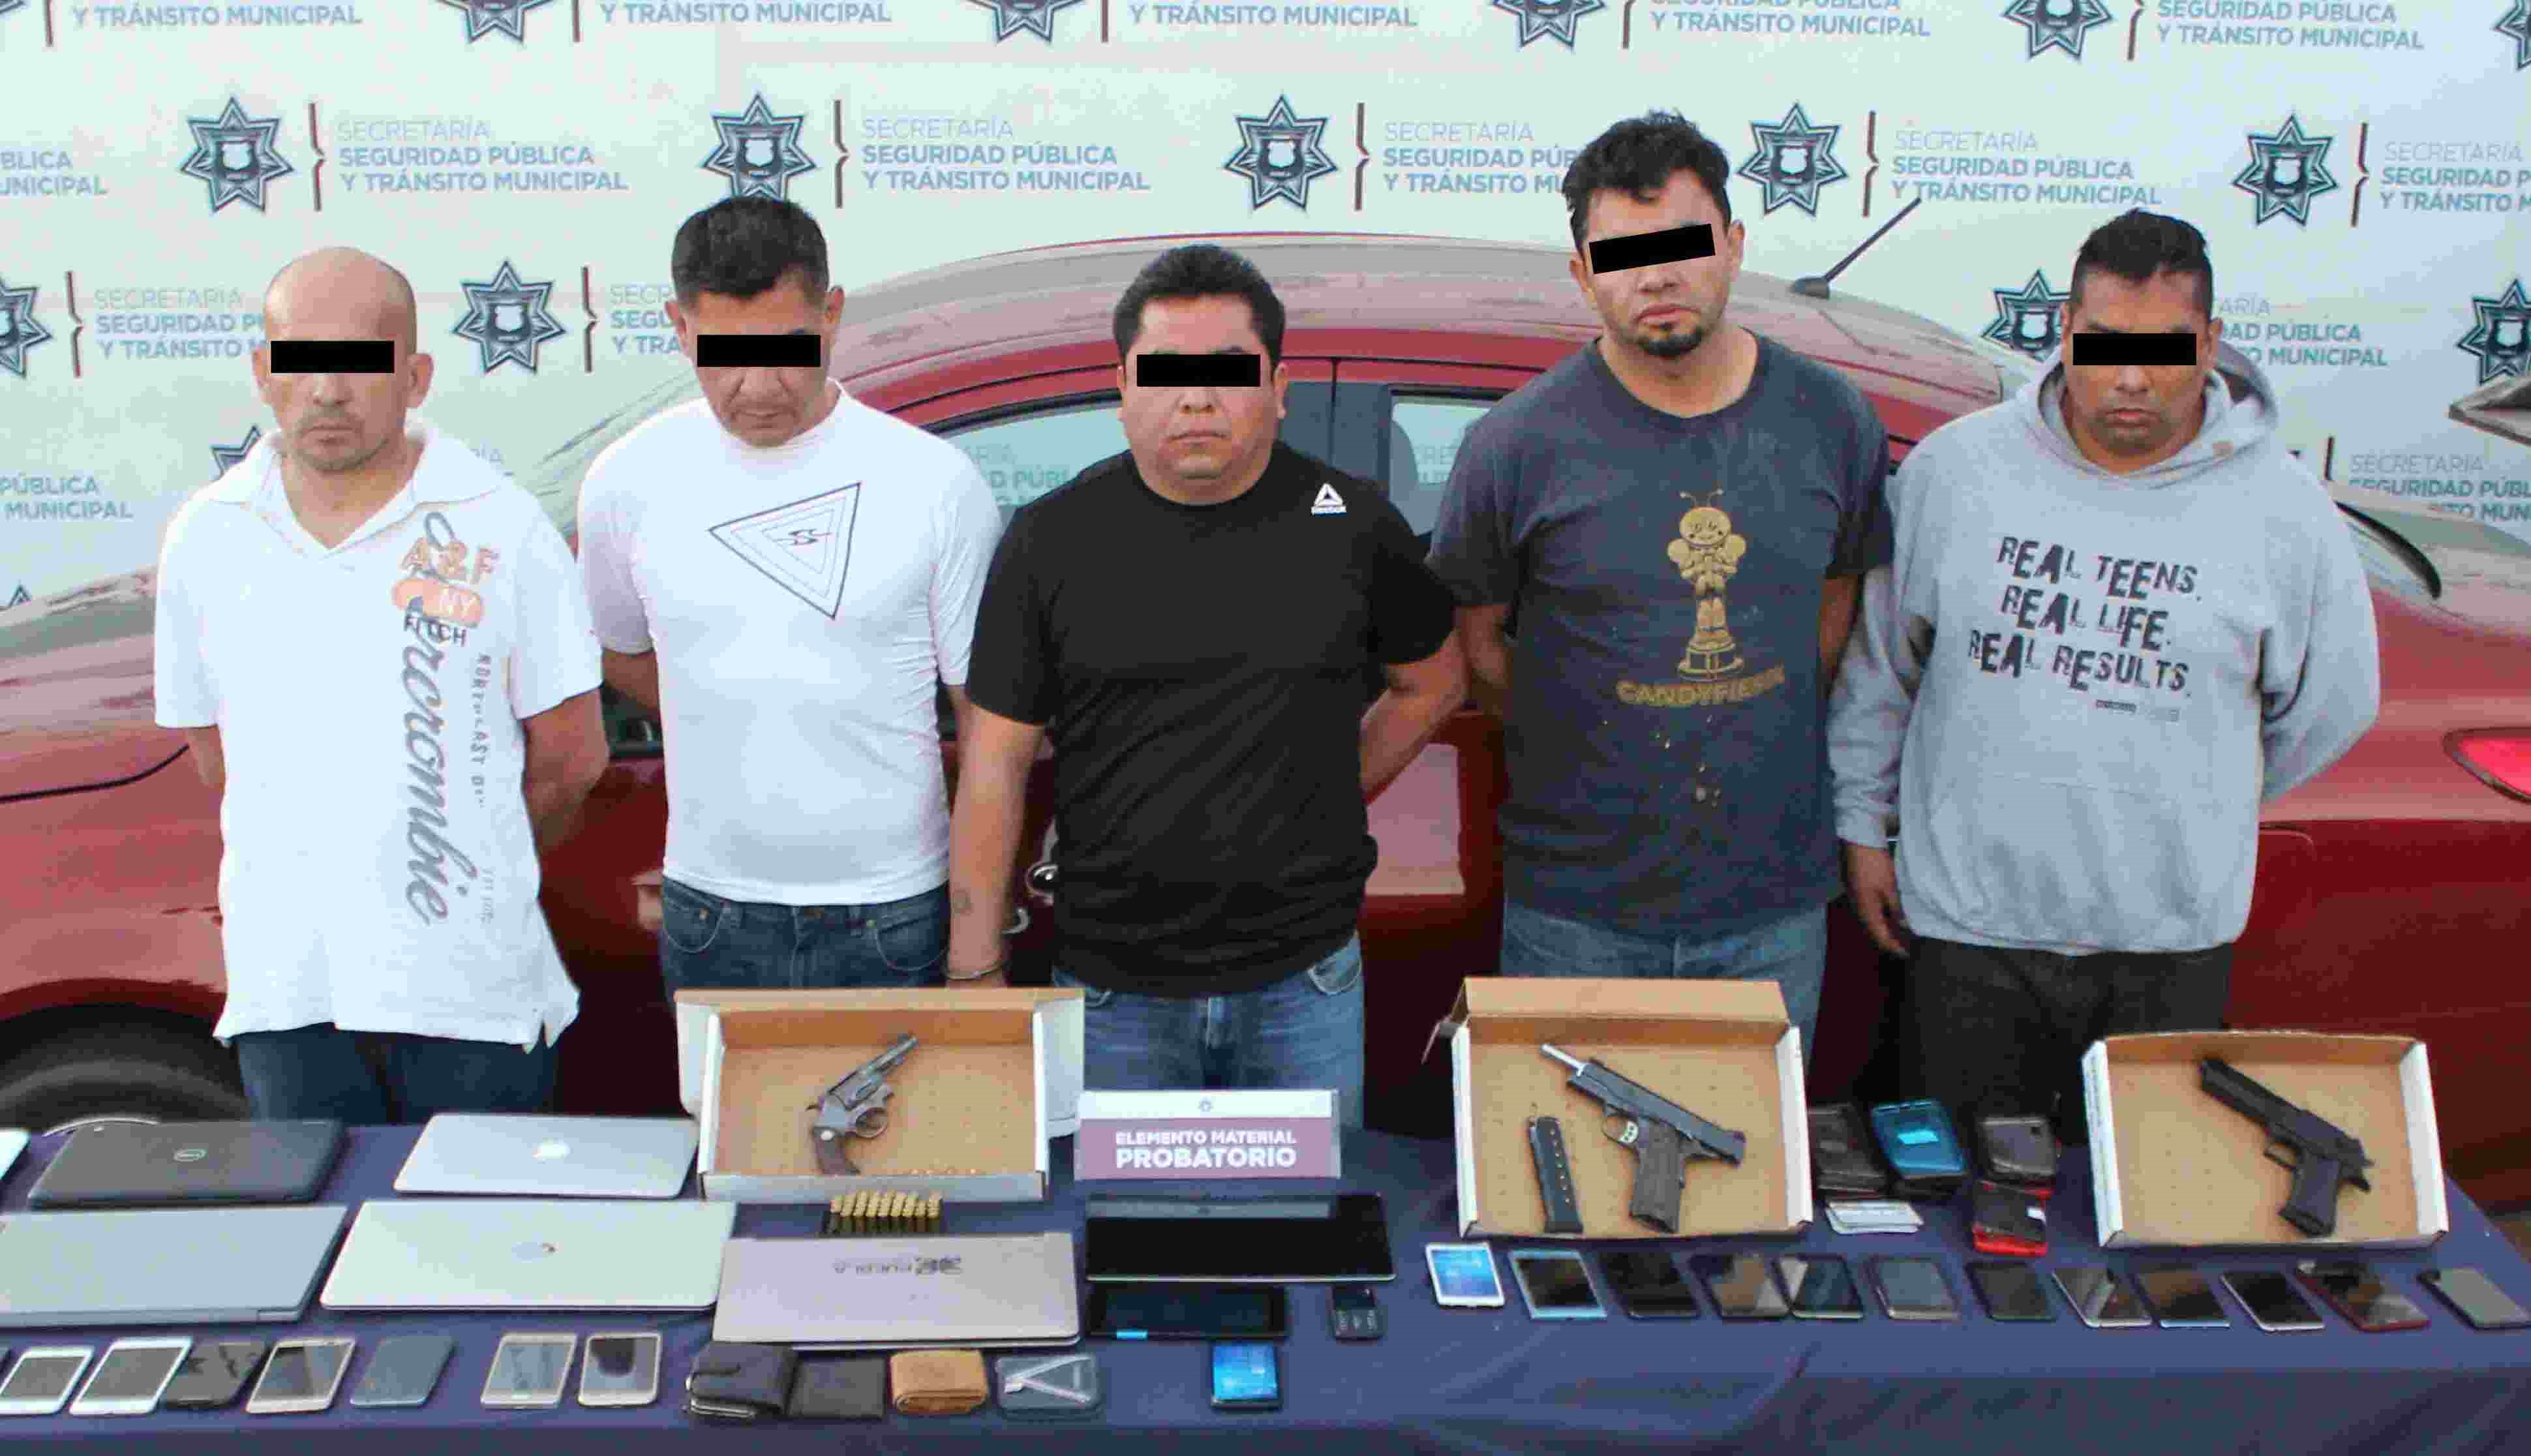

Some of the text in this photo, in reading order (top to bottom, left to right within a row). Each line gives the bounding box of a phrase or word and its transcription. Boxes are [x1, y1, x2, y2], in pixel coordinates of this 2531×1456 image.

[73, 5, 363, 28] Y TRÁNSITO MUNICIPAL
[601, 3, 615, 23] Y
[757, 2, 892, 22] MUNICIPAL
[1129, 1, 1417, 27] Y TRÁNSITO MUNICIPAL
[2159, 0, 2291, 20] SEGURIDAD
[1650, 9, 1931, 36] Y TRÁNSITO MUNICIPAL
[2158, 22, 2424, 50] Y TRÁNSITO MUNICIPAL
[340, 141, 594, 166] SEGURIDAD PÚBLICA
[862, 141, 1117, 164] SEGURIDAD PÚBLICA
[1384, 147, 1524, 168] SEGURIDAD
[1892, 154, 2134, 179] SEGURIDAD PÚBLICA
[2381, 167, 2511, 187] SEGURIDAD
[341, 168, 628, 192] Y TRÁNSITO MUNICIPAL
[862, 167, 1151, 190] Y TRÁNSITO MUNICIPAL
[1384, 173, 1398, 191] Y
[1408, 168, 1527, 193] TRÁNSITO
[1892, 181, 1907, 199] Y
[2036, 184, 2162, 205] MUNICIPAL
[2381, 192, 2393, 209] Y
[2401, 189, 2511, 212] TRÁNSITO
[96, 314, 235, 334] SEGURIDAD
[2267, 318, 2361, 342] PÚBLICA
[99, 339, 113, 359] Y
[119, 335, 242, 359] TRÁNSITO
[2268, 346, 2389, 367] MUNICIPAL
[4, 500, 134, 521] MUNICIPAL
[1997, 536, 2202, 602] REAL TEENS.
[2001, 584, 2172, 652] REAL LIFE.
[1967, 629, 2191, 699] REAL RESULTS.
[1115, 1130, 1297, 1145] ELEMENTO MATERIAL
[1116, 1147, 1297, 1168] PROBATORIO
